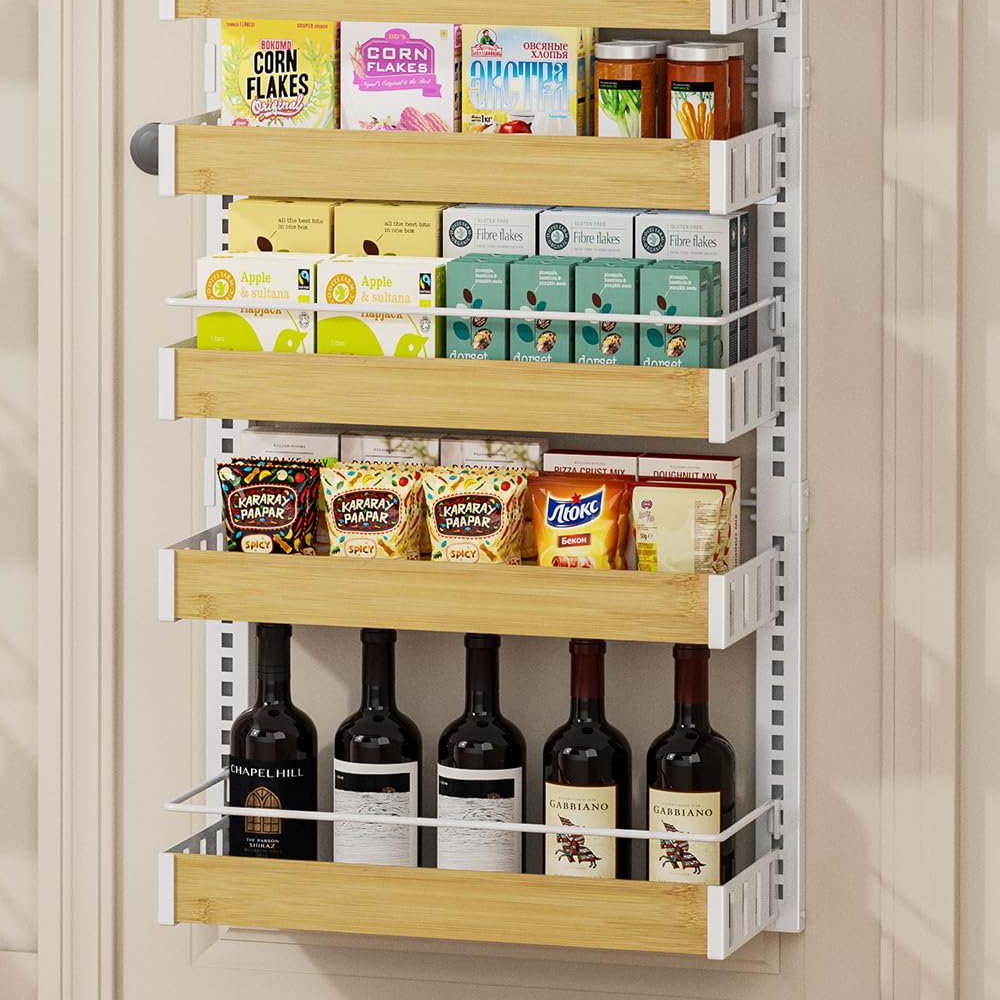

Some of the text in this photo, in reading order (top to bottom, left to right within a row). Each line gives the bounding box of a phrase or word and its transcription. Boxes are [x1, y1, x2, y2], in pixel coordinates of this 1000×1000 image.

[261, 41, 291, 50] BOKOMO
[368, 47, 428, 60] CORN
[254, 49, 298, 74] CORN
[367, 62, 428, 74] FLAKES
[247, 74, 308, 100] FLAKES
[251, 93, 304, 122] Original
[476, 228, 524, 241] Fibre flakes
[574, 231, 621, 245] Fibre flakes
[670, 234, 717, 248] Fibre flakes
[240, 272, 272, 285] Apple
[361, 275, 392, 290] Apple
[240, 288, 290, 298] & sultana
[361, 292, 411, 303] & sultana
[238, 494, 290, 508] KARARAY
[342, 498, 394, 512] KARARAY
[240, 506, 285, 520] PAAPAR
[444, 502, 497, 517] KARARAY
[344, 511, 389, 524] PAAPAR
[446, 515, 491, 529] PAAPAR
[245, 541, 271, 550] SPICY
[561, 536, 588, 546] Бекон
[348, 546, 375, 554] SPICY
[450, 550, 476, 559] SPICY
[230, 764, 304, 778] CHAPEL HILL
[550, 799, 609, 811] GABBIANO
[653, 805, 713, 817] GABBIANO
